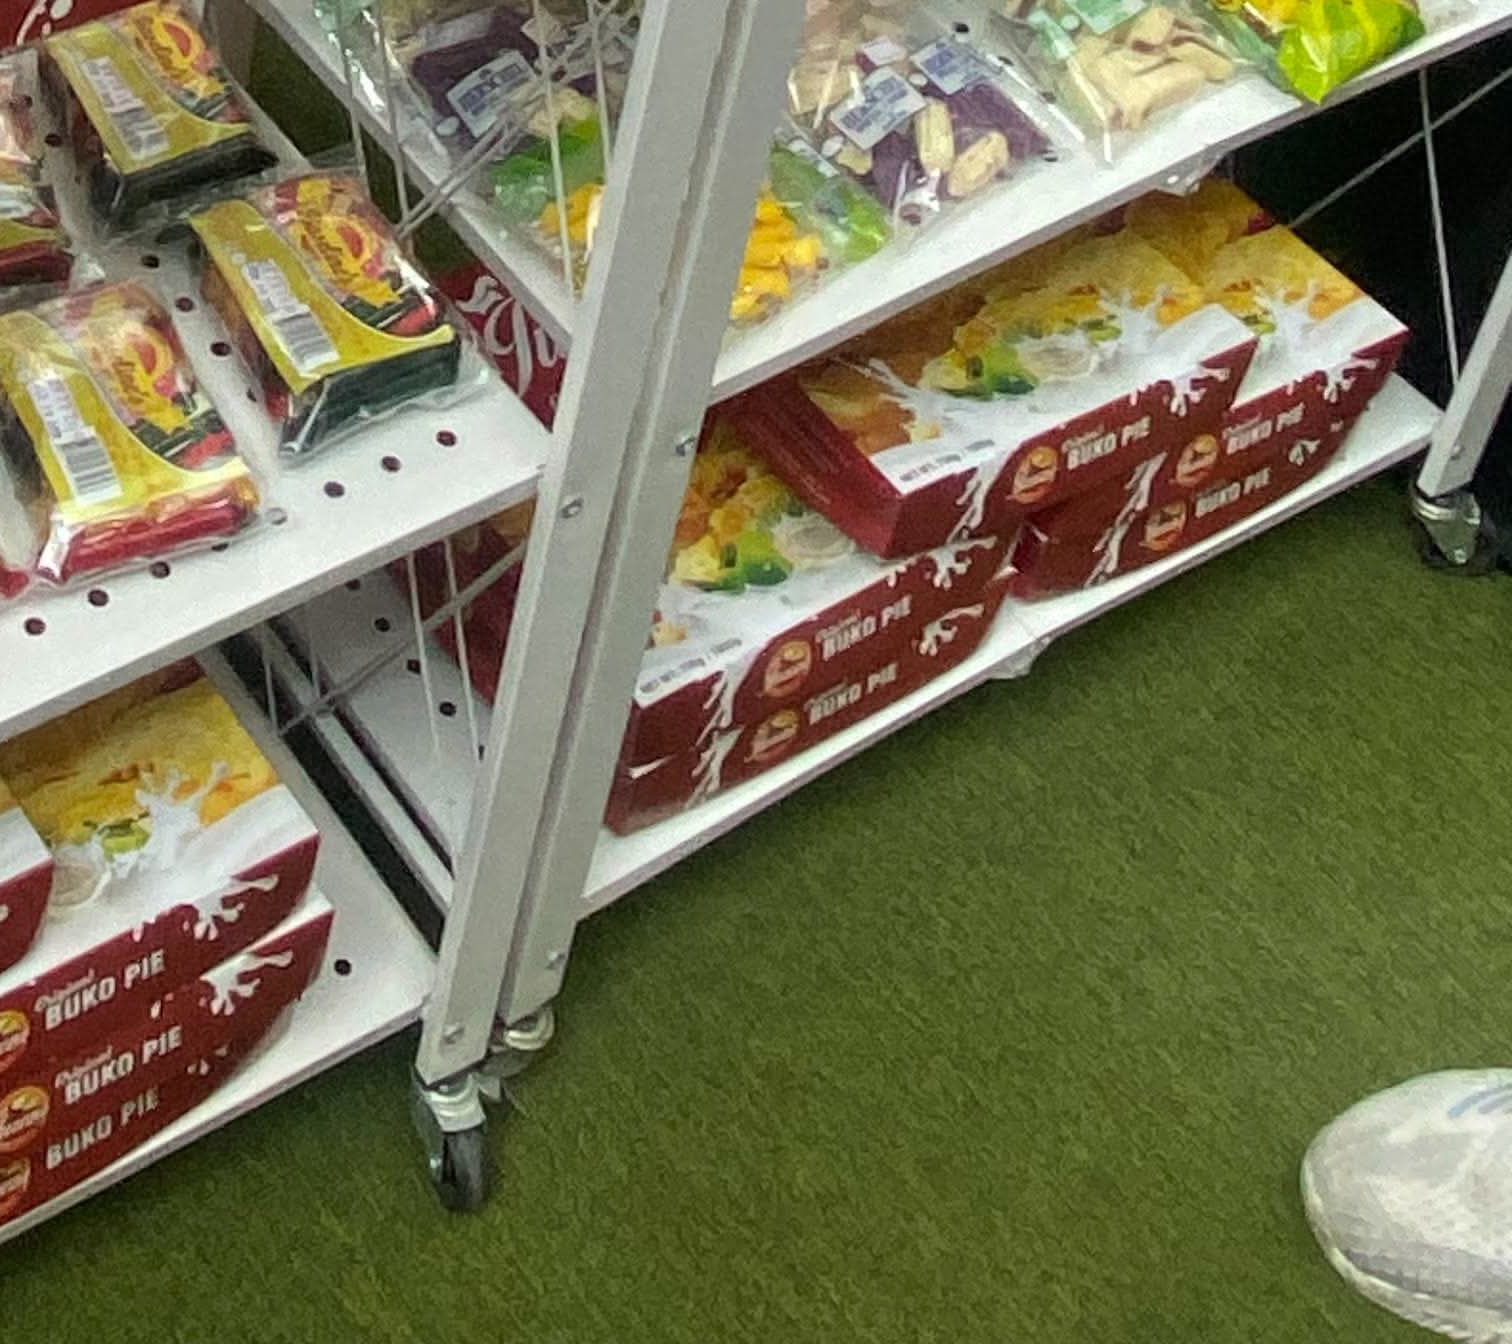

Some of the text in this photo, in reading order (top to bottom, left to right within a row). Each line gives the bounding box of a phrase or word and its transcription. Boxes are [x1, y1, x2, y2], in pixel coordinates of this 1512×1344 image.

[45, 948, 165, 1031] BUKO PIE
[64, 1025, 183, 1105] BUKO PIE
[45, 1087, 161, 1170] BUKO PIE
